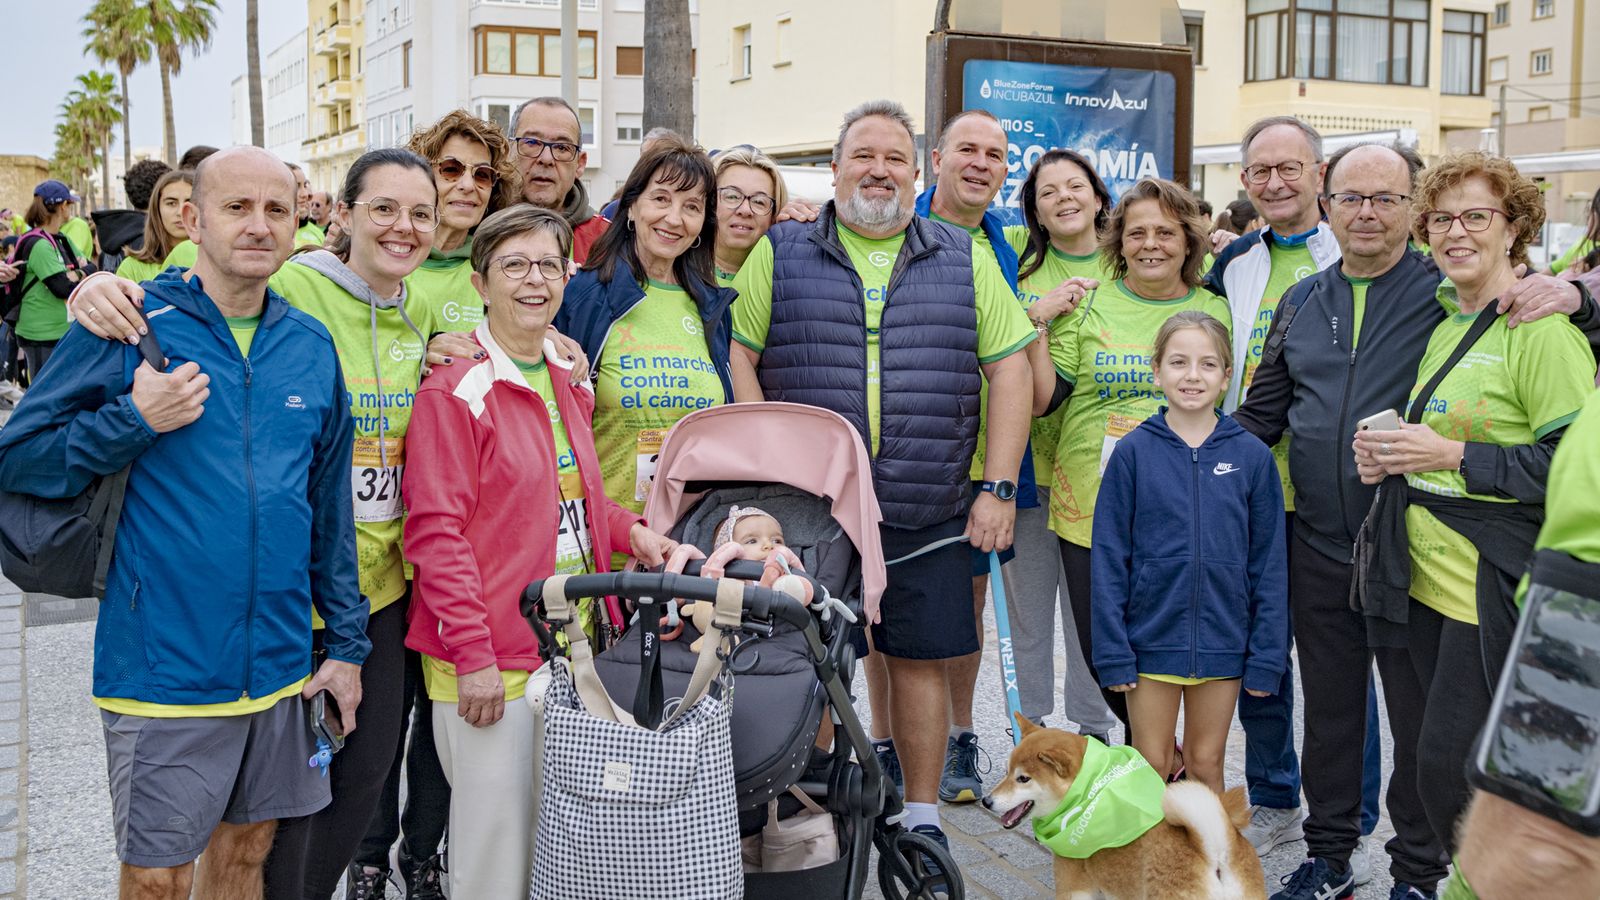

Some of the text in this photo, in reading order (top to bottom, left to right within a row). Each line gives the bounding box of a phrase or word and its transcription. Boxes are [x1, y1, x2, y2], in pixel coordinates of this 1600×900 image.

[993, 79, 1054, 92] BlueZoneForum
[992, 90, 1056, 105] INCUBAZUL
[1065, 88, 1148, 111] InnovAzul
[620, 355, 716, 375] En marcha
[1095, 352, 1116, 366] En
[620, 372, 689, 389] contra
[360, 388, 415, 408] march
[621, 391, 715, 409] el cáncer
[1098, 386, 1168, 401] el cánc
[1216, 462, 1233, 471] NIKE
[356, 466, 402, 502] 321
[644, 631, 655, 648] fox
[1000, 637, 1019, 692] XTRM
